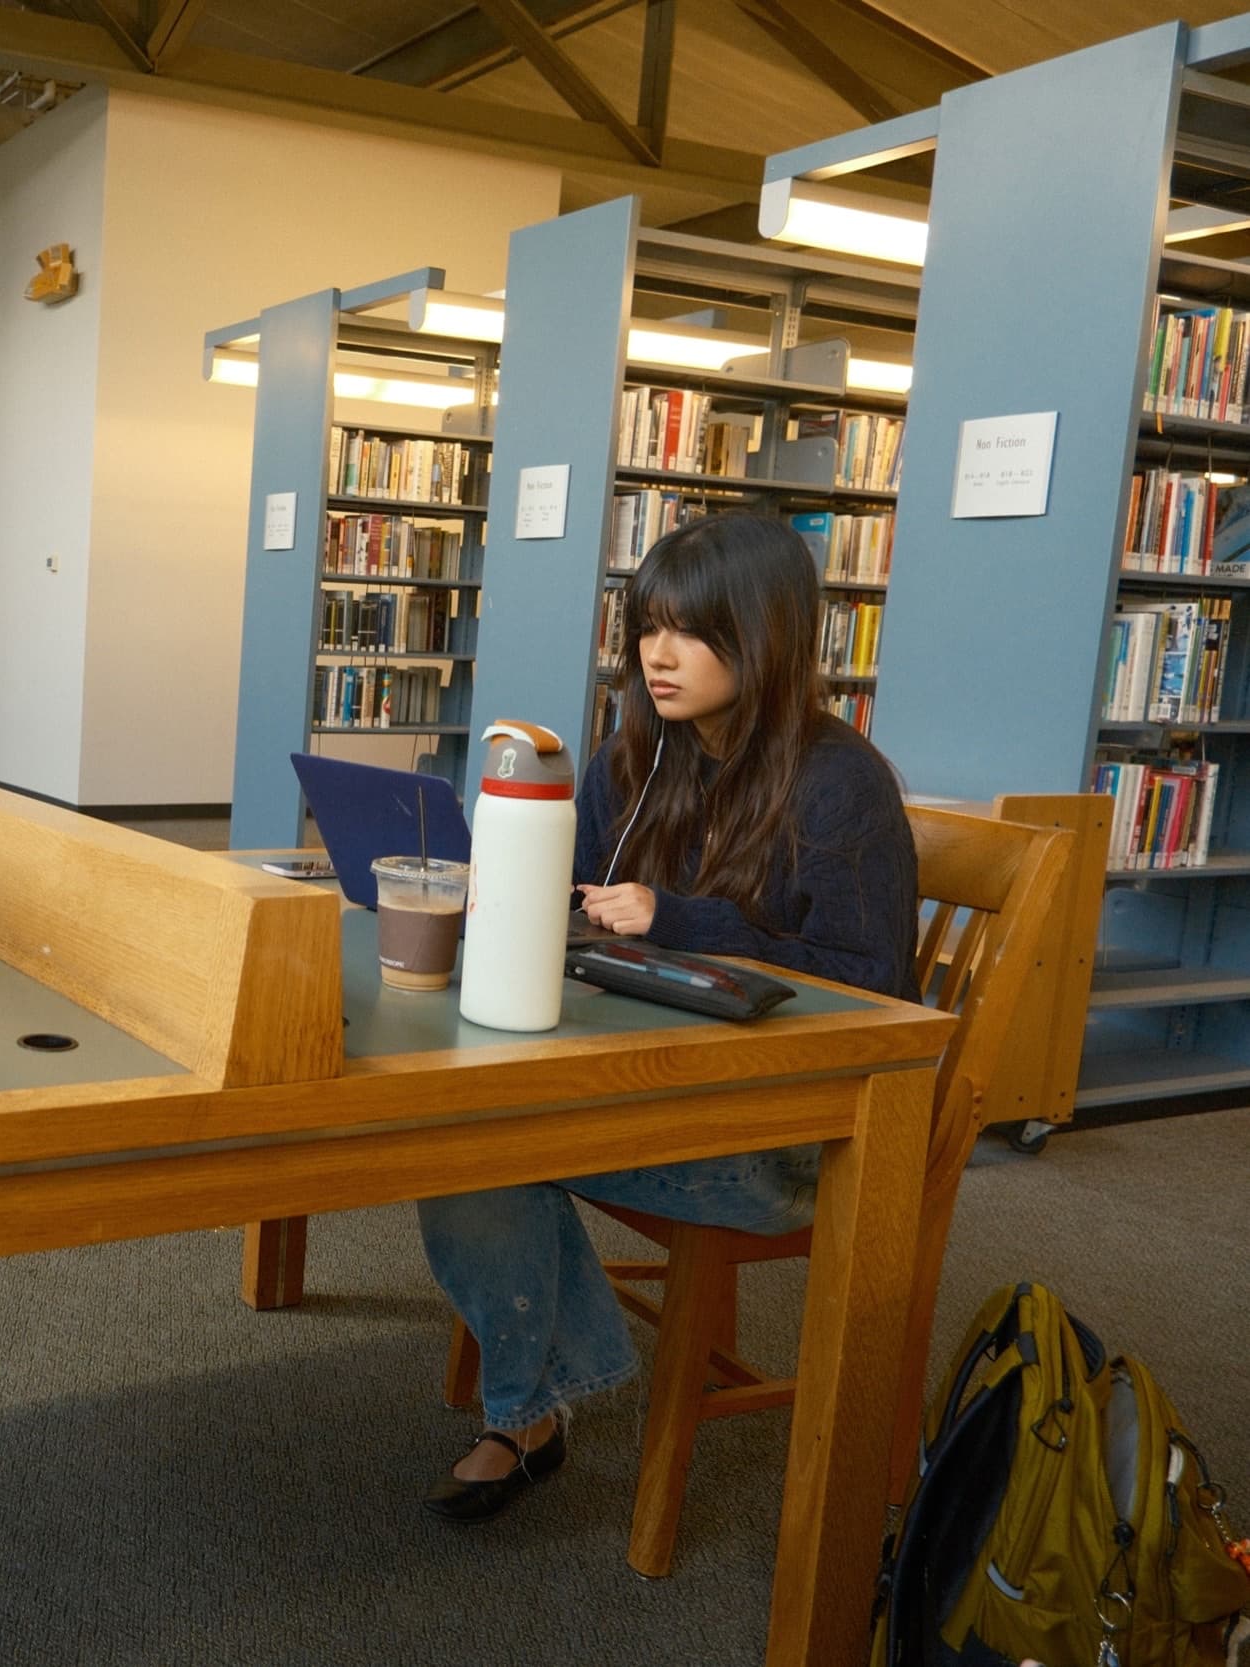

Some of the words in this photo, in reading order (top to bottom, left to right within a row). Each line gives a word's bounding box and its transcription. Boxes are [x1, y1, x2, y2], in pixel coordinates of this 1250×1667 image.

[976, 438, 991, 450] Non
[996, 435, 1027, 449] Fiction
[1215, 563, 1247, 573] MADE
